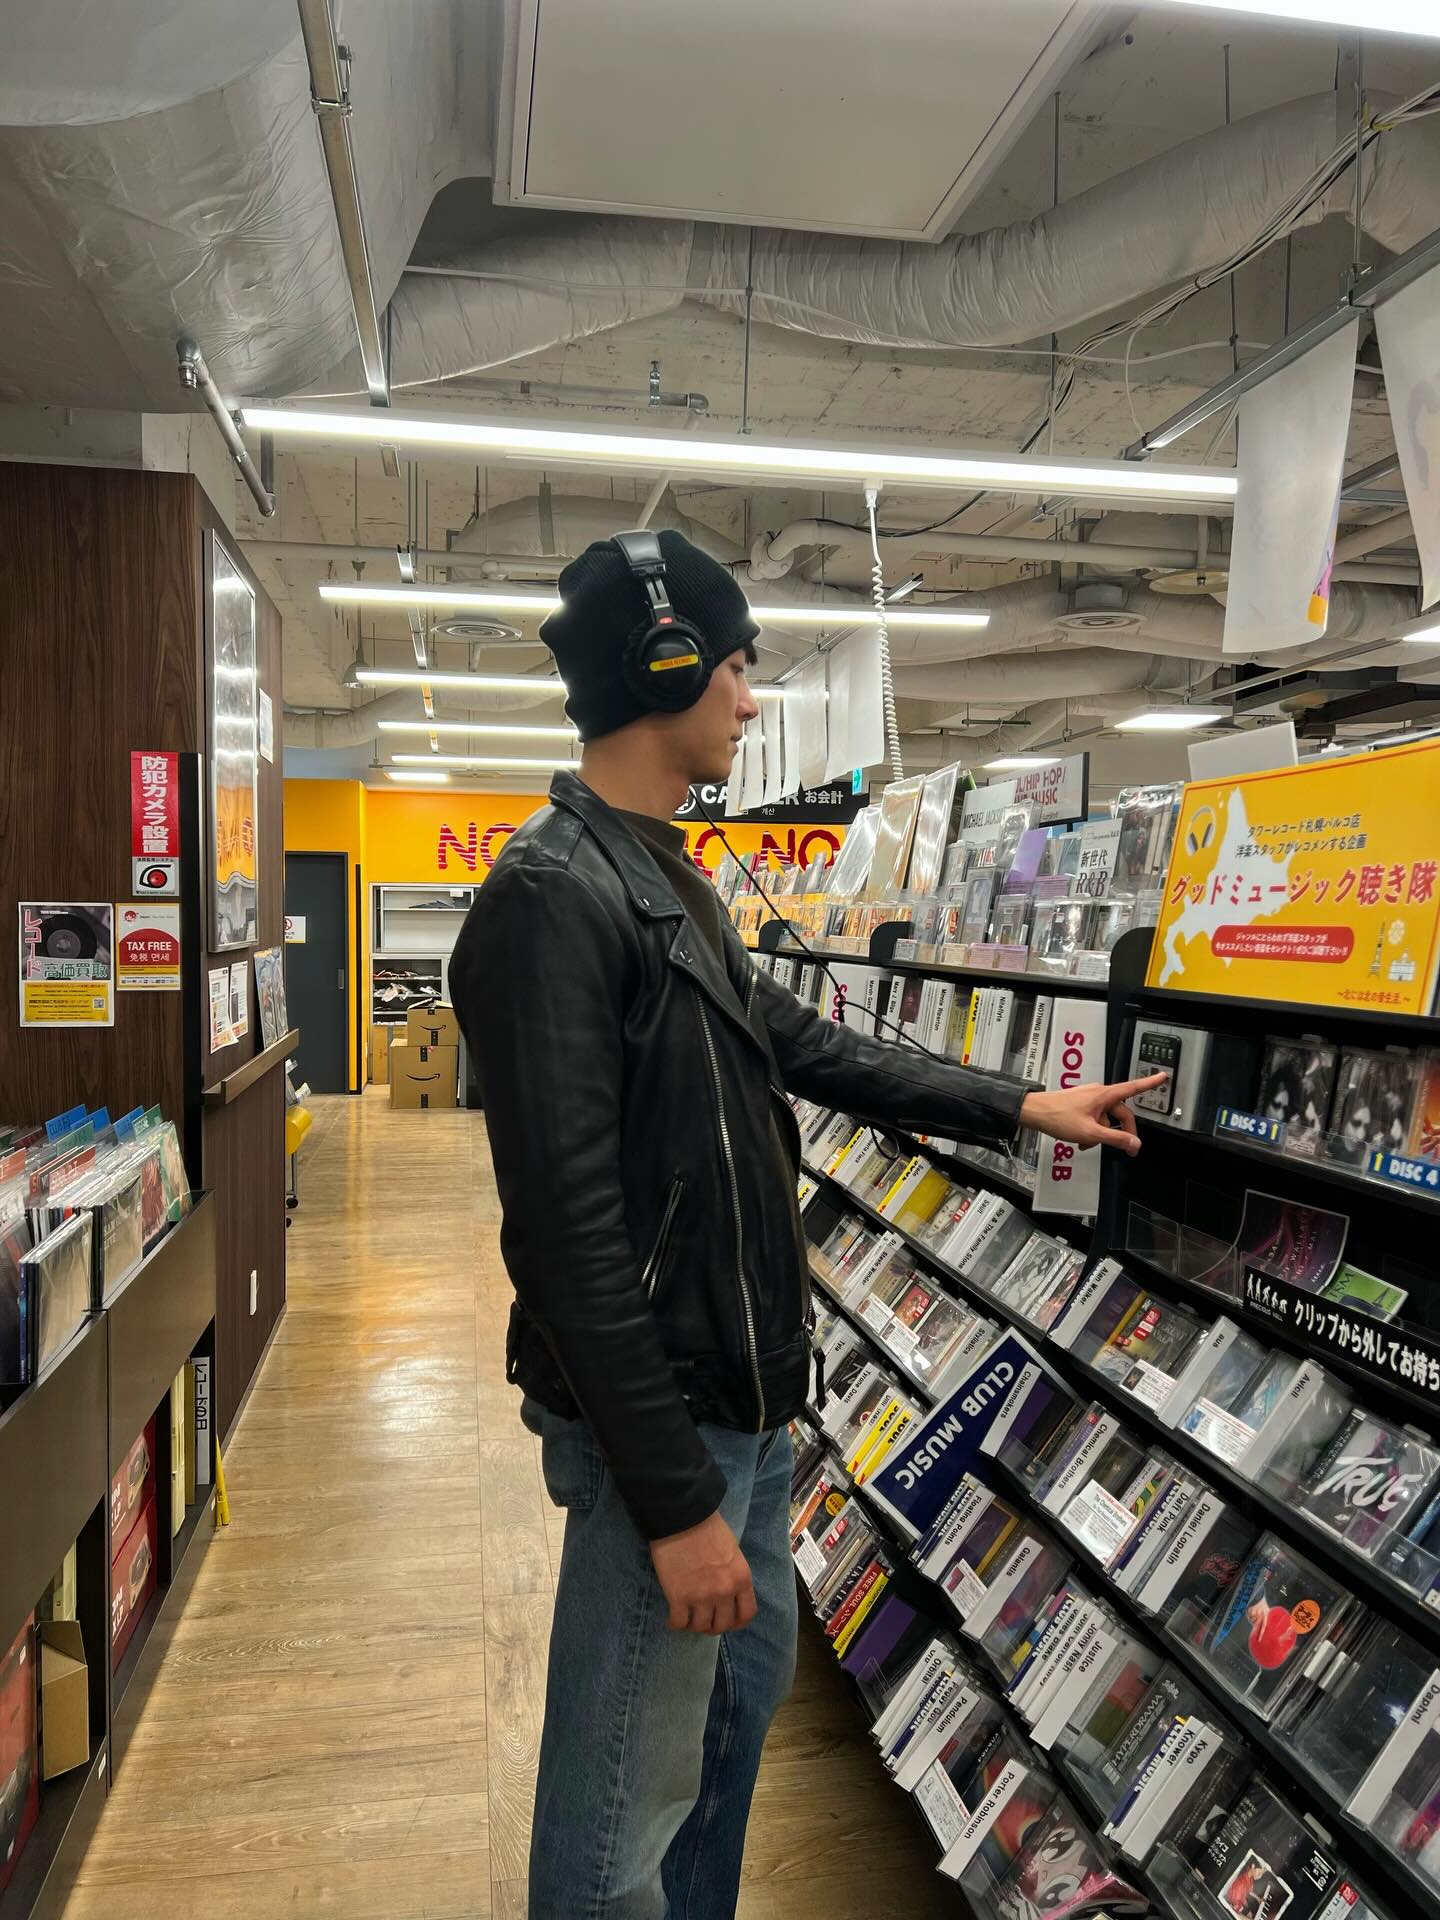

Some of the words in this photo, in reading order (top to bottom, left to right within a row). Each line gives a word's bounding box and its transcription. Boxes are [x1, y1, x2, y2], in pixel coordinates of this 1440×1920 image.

[141, 755, 169, 854] 防犯カメラ設置
[804, 790, 844, 805] お会計
[1247, 813, 1361, 838] タワーレコード札幌パルコ店
[1080, 849, 1108, 868] 新世代
[1076, 870, 1108, 897] R&B
[1170, 861, 1438, 905] グッドミュージック聴き隊
[24, 911, 43, 977] レコード
[126, 941, 146, 951] TAX
[147, 941, 172, 951] FREE
[129, 952, 149, 962] 免税
[150, 952, 170, 962] 면세
[43, 962, 108, 979] 高価買取
[1036, 1002, 1046, 1031] NOTHING
[1025, 1061, 1036, 1079] FUNK
[1059, 1031, 1085, 1089] SOU
[1230, 1113, 1257, 1132] DISC
[1257, 1122, 1267, 1136] 3
[911, 1163, 923, 1177] Sade
[1389, 1156, 1423, 1182] DISC
[1426, 1168, 1439, 1187] 4
[977, 1199, 989, 1215] Sault
[970, 1231, 988, 1256] Family
[957, 1249, 972, 1270] Stone
[861, 1266, 878, 1287] Wonder
[1095, 1267, 1109, 1284] Alan
[1079, 1281, 1098, 1305] Walker
[834, 1340, 846, 1353] Tyla
[963, 1327, 986, 1356] Stylistics
[1295, 1299, 1440, 1391] クリップから外してお持ち
[855, 1370, 872, 1392] Tyrone
[960, 1360, 1015, 1417] CLUB
[1000, 1370, 1032, 1419] Chainsmokers
[1291, 1373, 1311, 1399] Avicii
[195, 1363, 208, 1430] レコードの日
[842, 1386, 857, 1404] Davis
[894, 1413, 964, 1490] MUSIC
[1081, 1423, 1109, 1457] Chemical
[1058, 1454, 1086, 1489] Brothers
[962, 1495, 982, 1525] Floating
[1174, 1492, 1188, 1511] Daft
[1157, 1509, 1176, 1533] Punk
[1190, 1503, 1211, 1532] Daniel
[944, 1521, 962, 1546] Points
[1166, 1530, 1193, 1566] Lopatin
[1006, 1547, 1031, 1577] Galantis
[864, 1571, 877, 1590] FREE
[851, 1586, 866, 1609] SOUL
[1079, 1623, 1097, 1650] Jonny
[1063, 1648, 1081, 1673] Nash
[1077, 1640, 1103, 1673] Justice
[920, 1658, 942, 1684] Orbital
[936, 1695, 968, 1733] Pendulum
[1410, 1683, 1440, 1726] Daphni
[1112, 1693, 1163, 1767] HYPERDRAMA
[1165, 1727, 1195, 1767] Knower
[1186, 1738, 1209, 1765] Kygo
[990, 1771, 1015, 1804] Porter
[963, 1799, 998, 1840] Robinson
